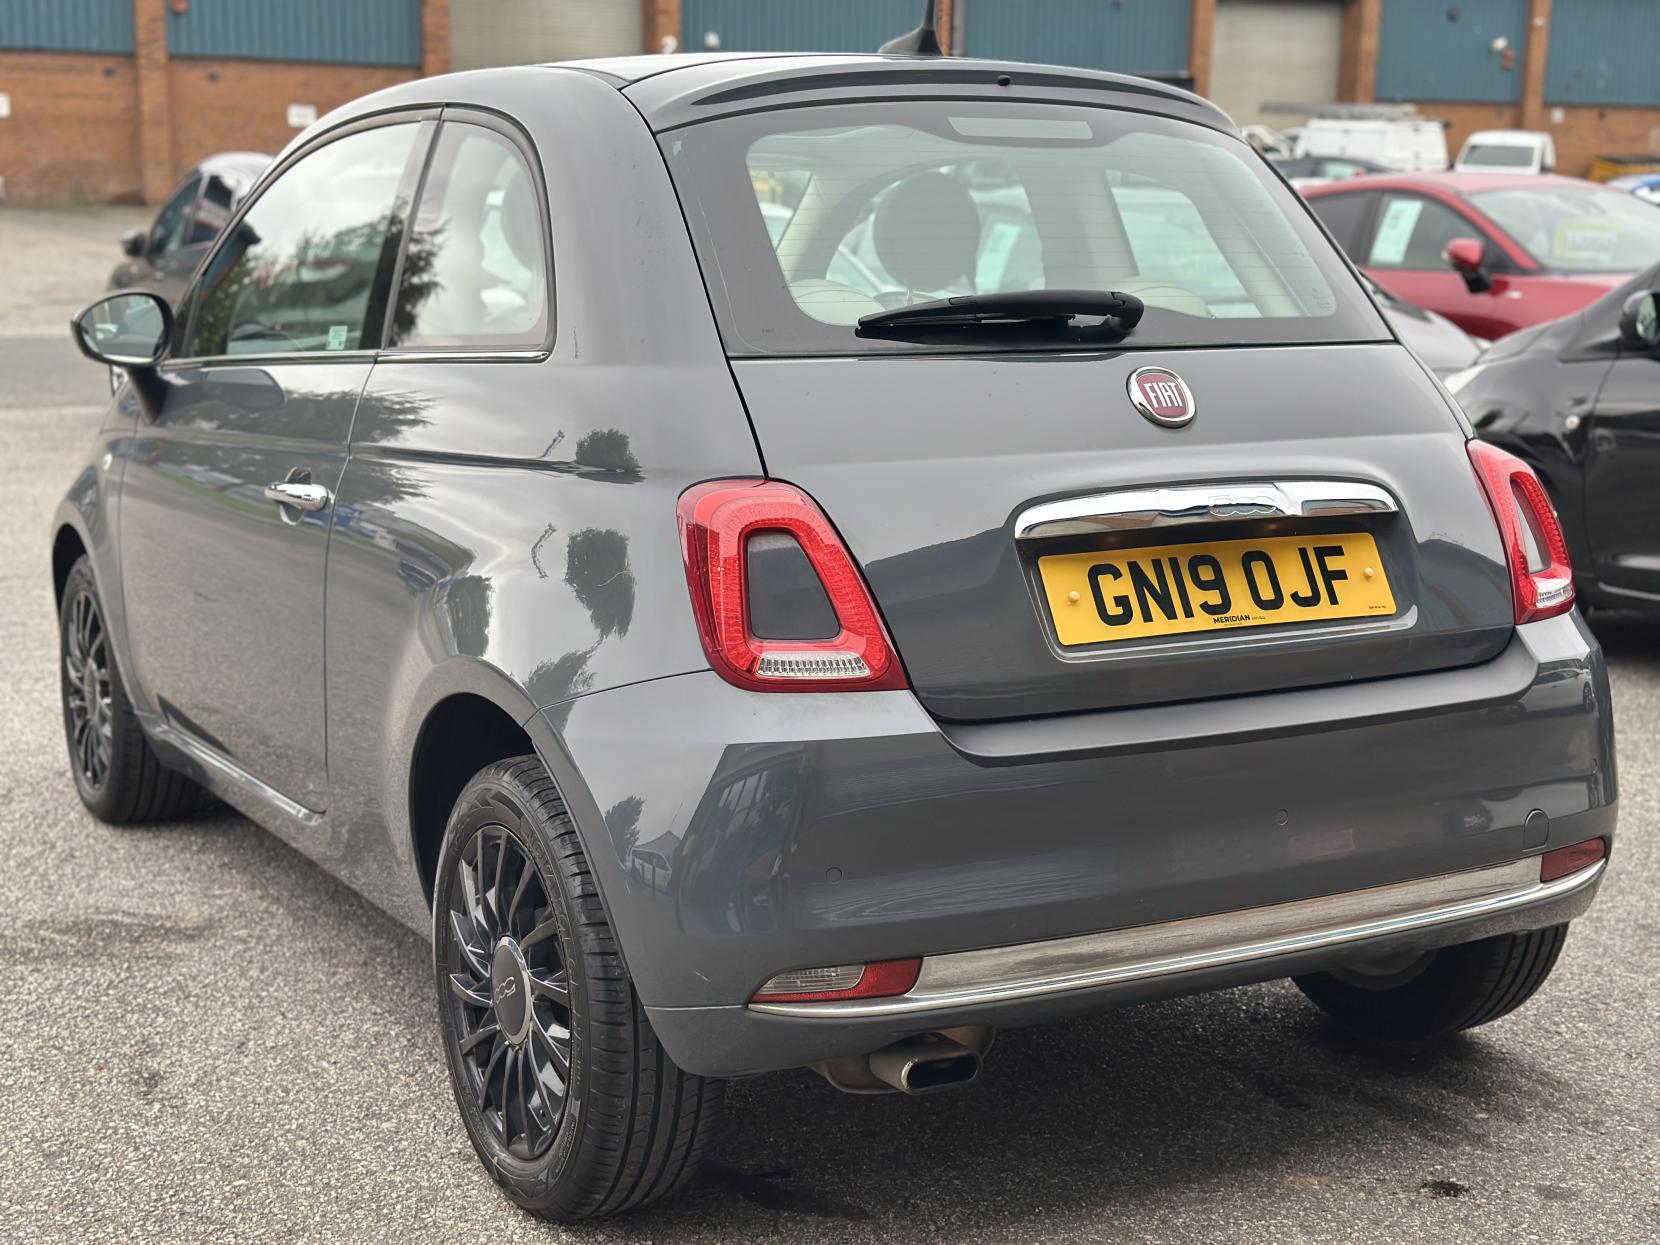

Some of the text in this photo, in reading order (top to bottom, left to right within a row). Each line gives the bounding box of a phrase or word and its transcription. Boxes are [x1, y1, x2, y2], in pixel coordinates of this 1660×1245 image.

[1143, 382, 1183, 408] FIAT
[1087, 545, 1349, 627] GN19 OJF
[1212, 614, 1251, 624] MERIDIAN
